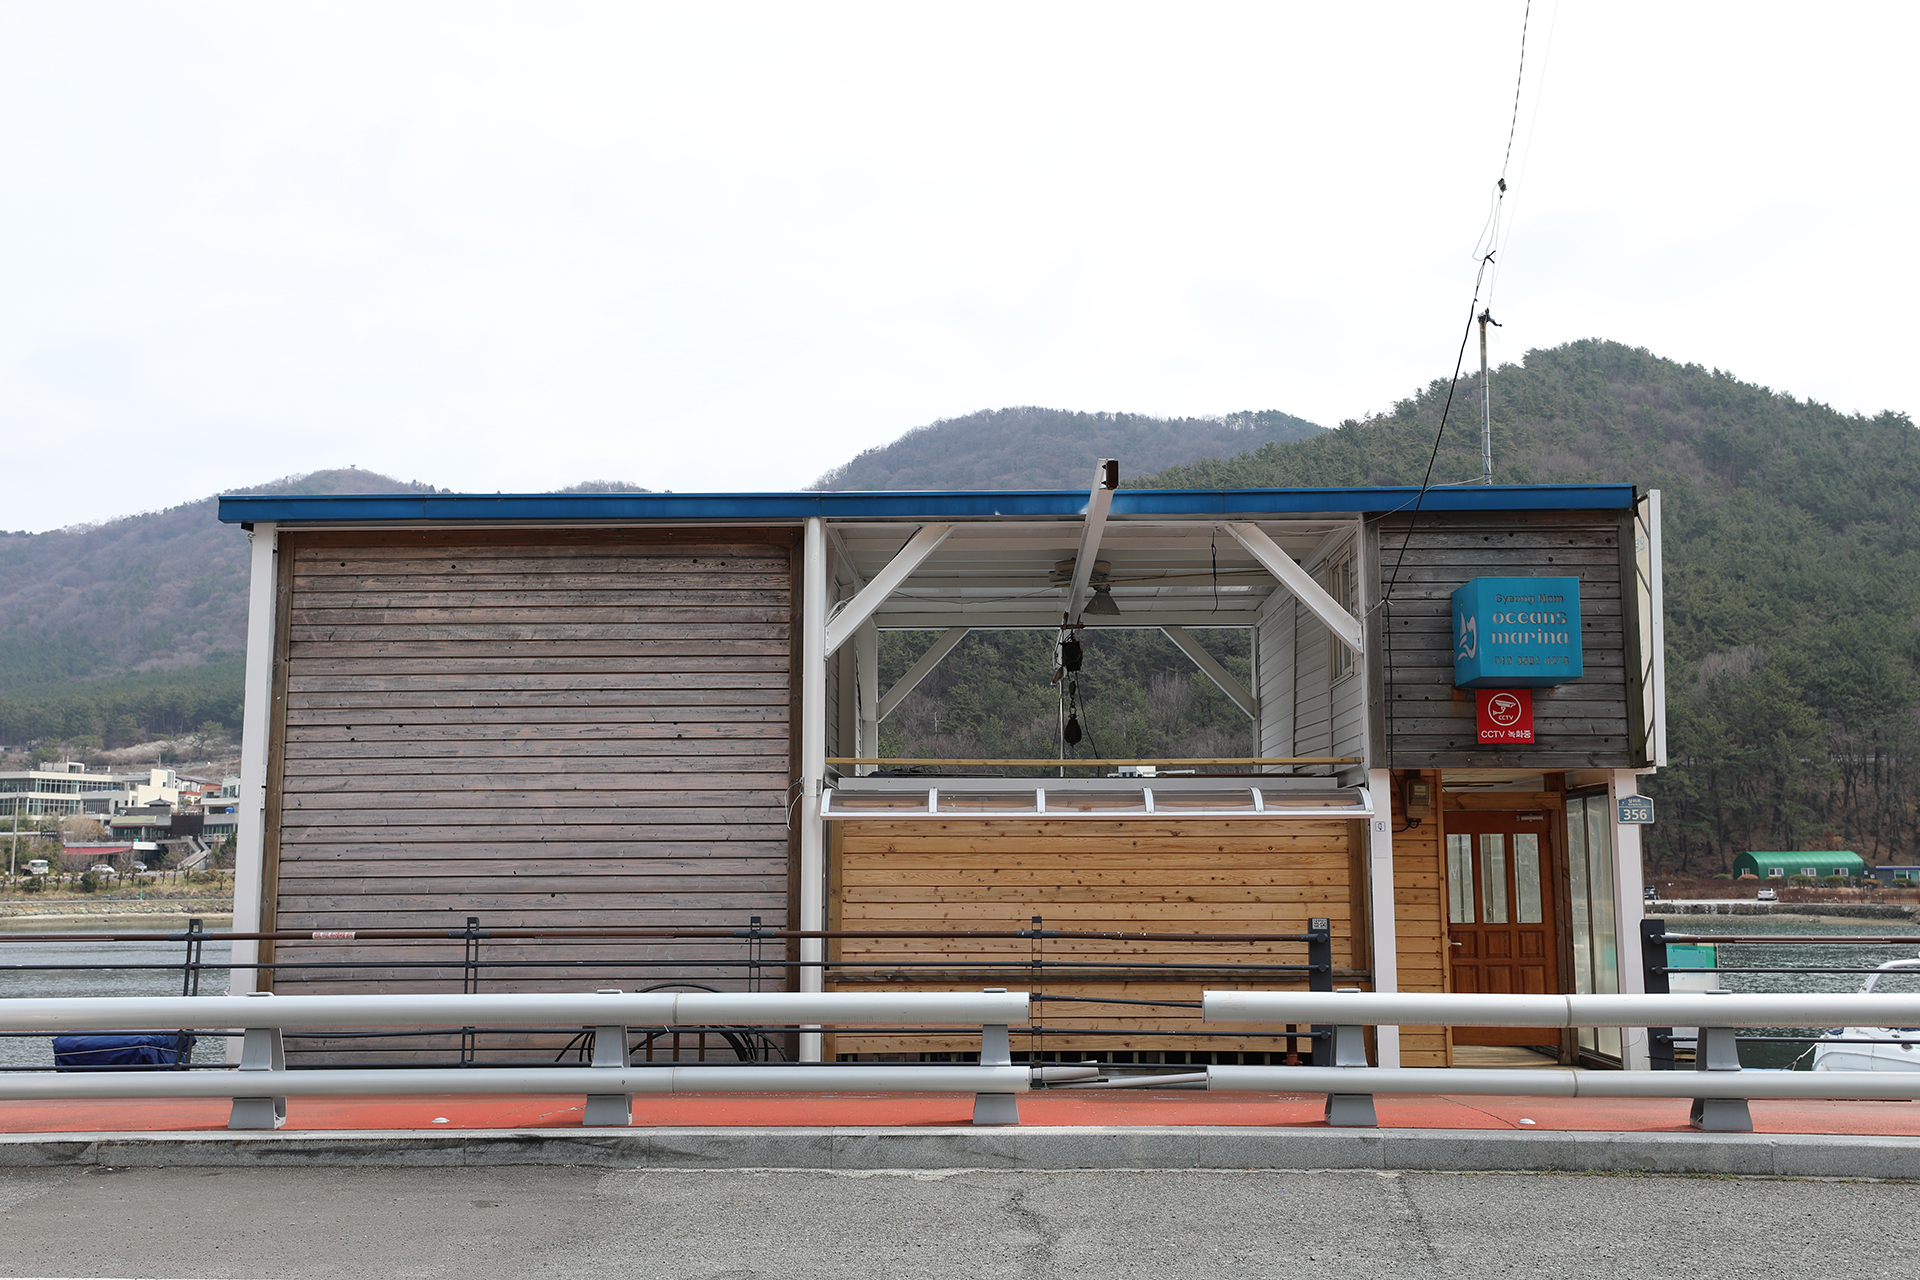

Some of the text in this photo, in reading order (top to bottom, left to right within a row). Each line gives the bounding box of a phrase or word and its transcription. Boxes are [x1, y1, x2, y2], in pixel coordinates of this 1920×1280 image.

[1495, 593, 1564, 605] Gyeong Nam
[1492, 611, 1567, 624] oceans
[1492, 628, 1569, 644] marina
[1494, 656, 1570, 665] 010 3581 4273
[1481, 730, 1531, 738] CCTV 녹화중
[1623, 809, 1648, 820] 356
